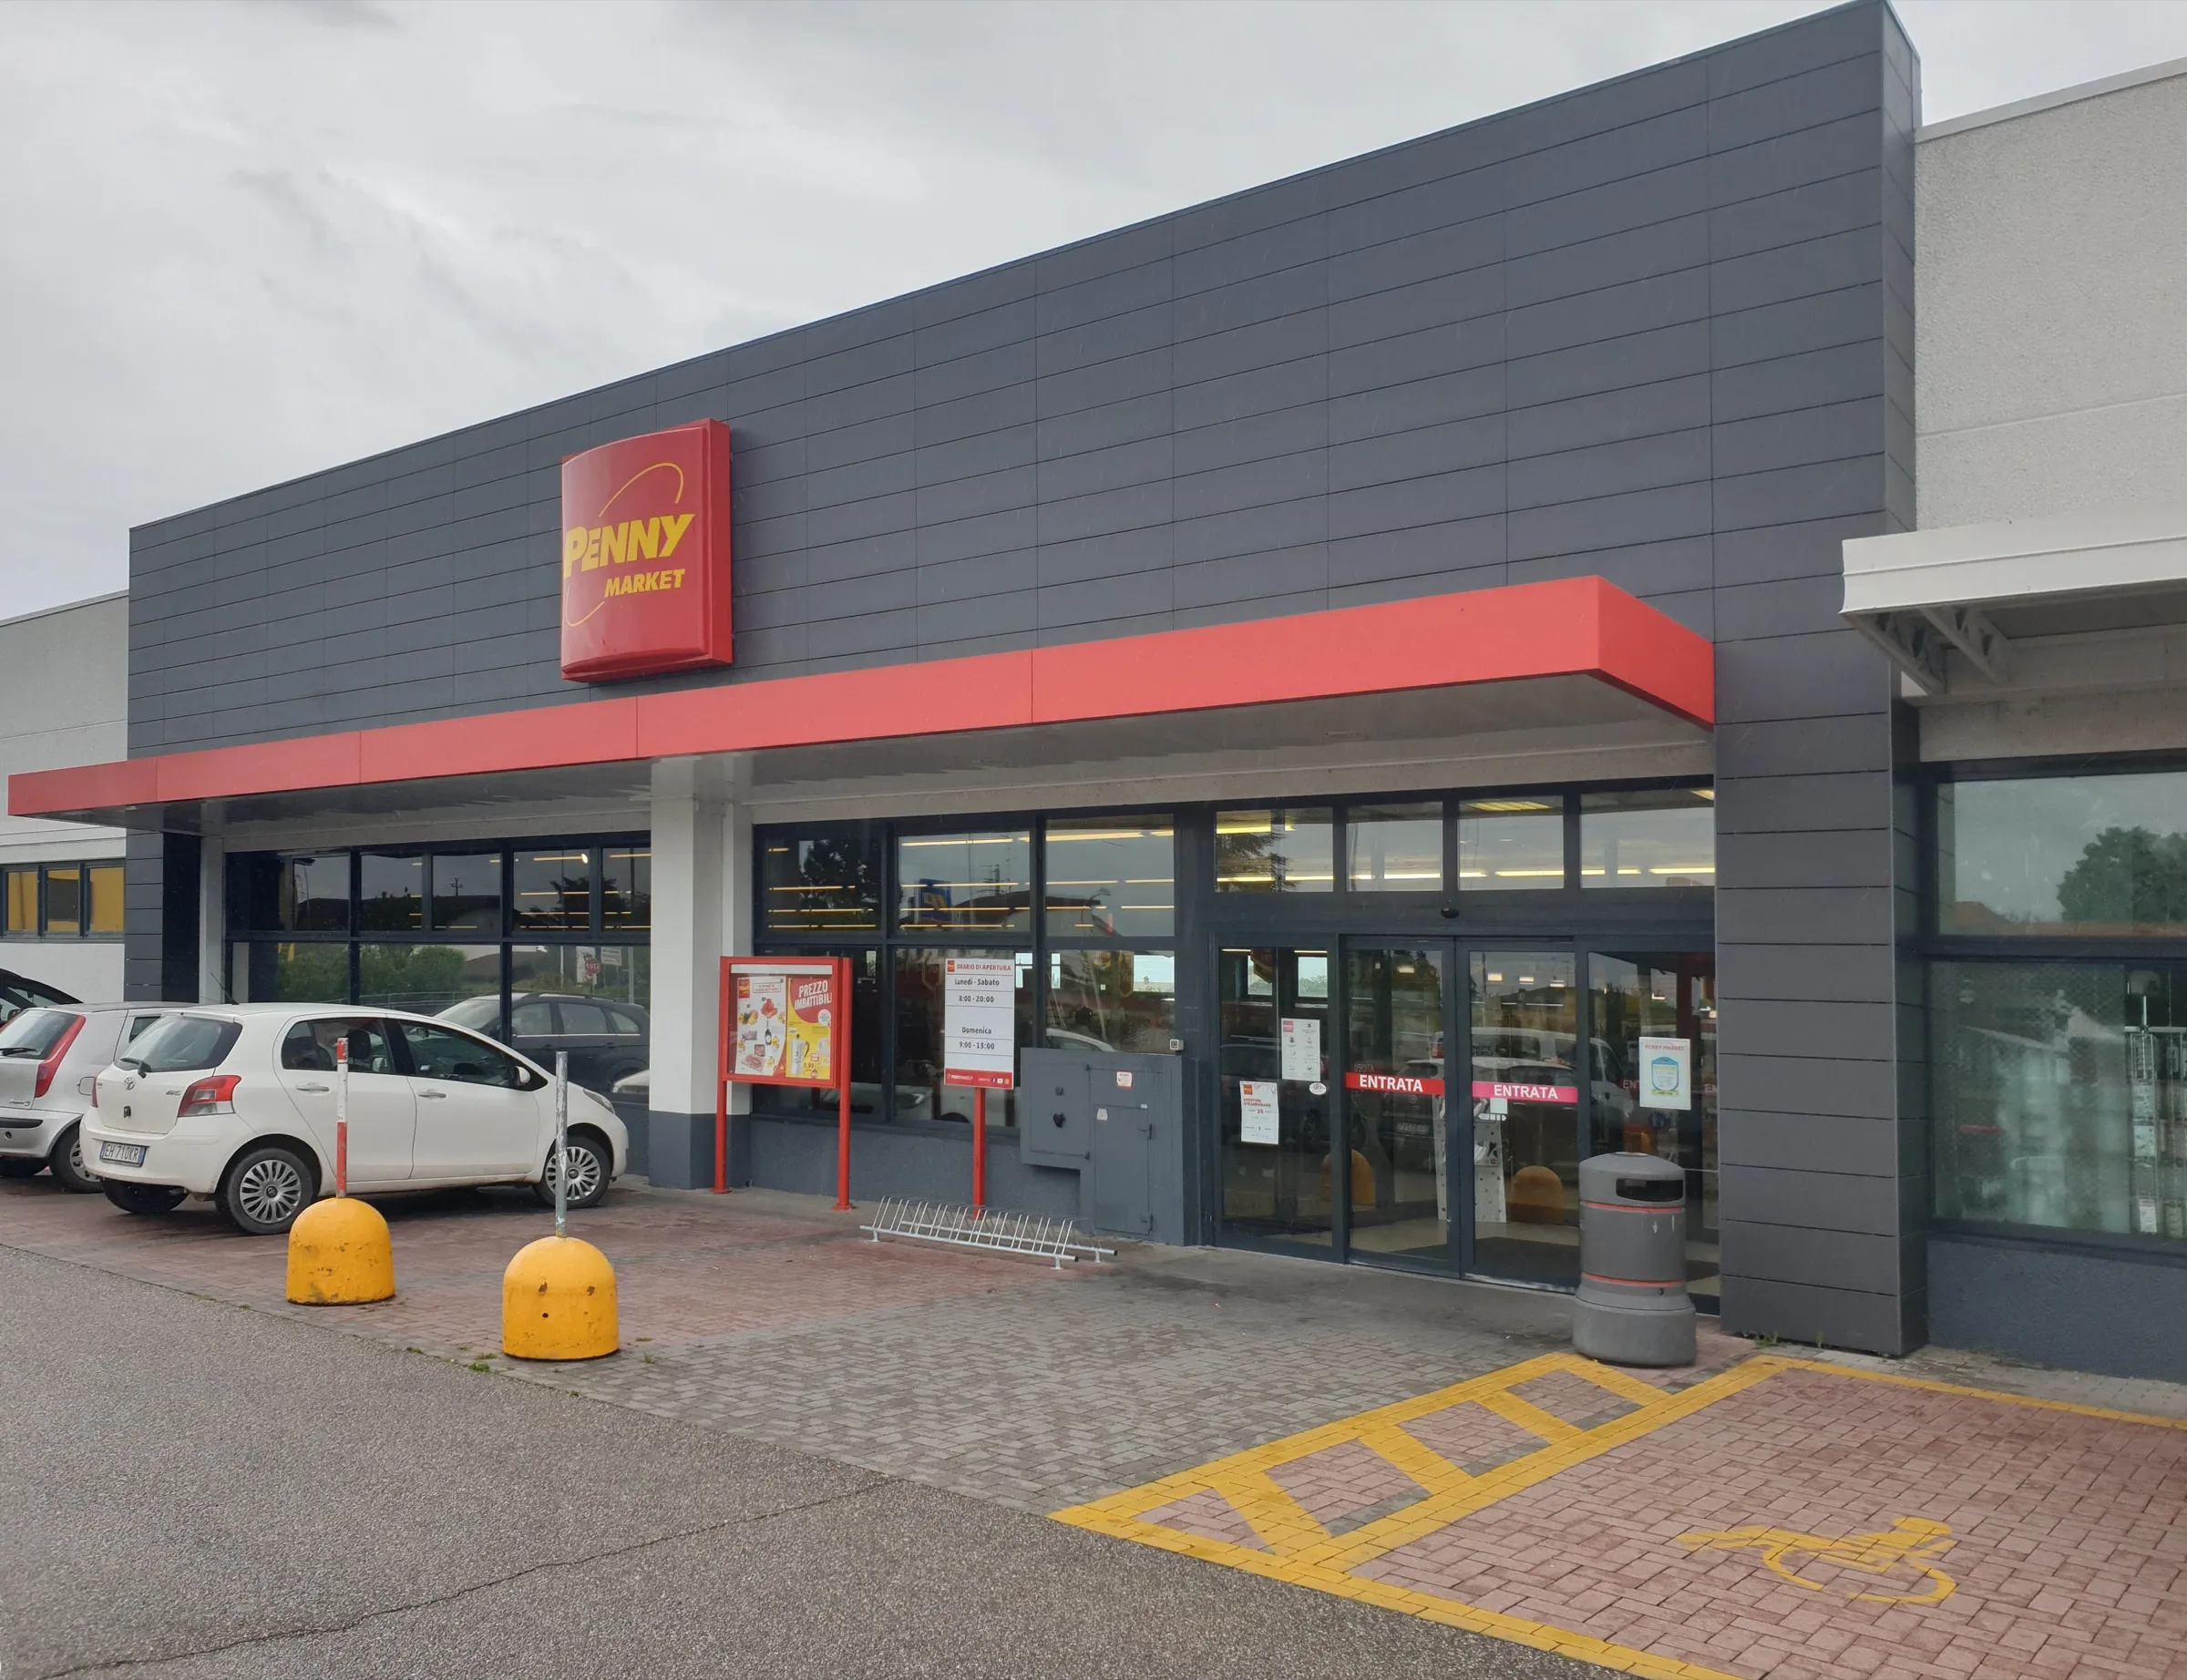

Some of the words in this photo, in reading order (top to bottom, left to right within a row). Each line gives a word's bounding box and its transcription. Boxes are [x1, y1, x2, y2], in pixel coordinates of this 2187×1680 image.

[563, 514, 695, 579] PENNY
[604, 569, 685, 598] MARKET
[798, 980, 828, 998] PREZZO
[976, 995, 994, 1003] 20:00
[961, 1027, 992, 1035] Domenica
[1359, 1075, 1423, 1092] ENTRATA
[1494, 1084, 1558, 1099] ENTRATA
[105, 1143, 117, 1158] EH
[115, 1145, 139, 1162] 710KR
